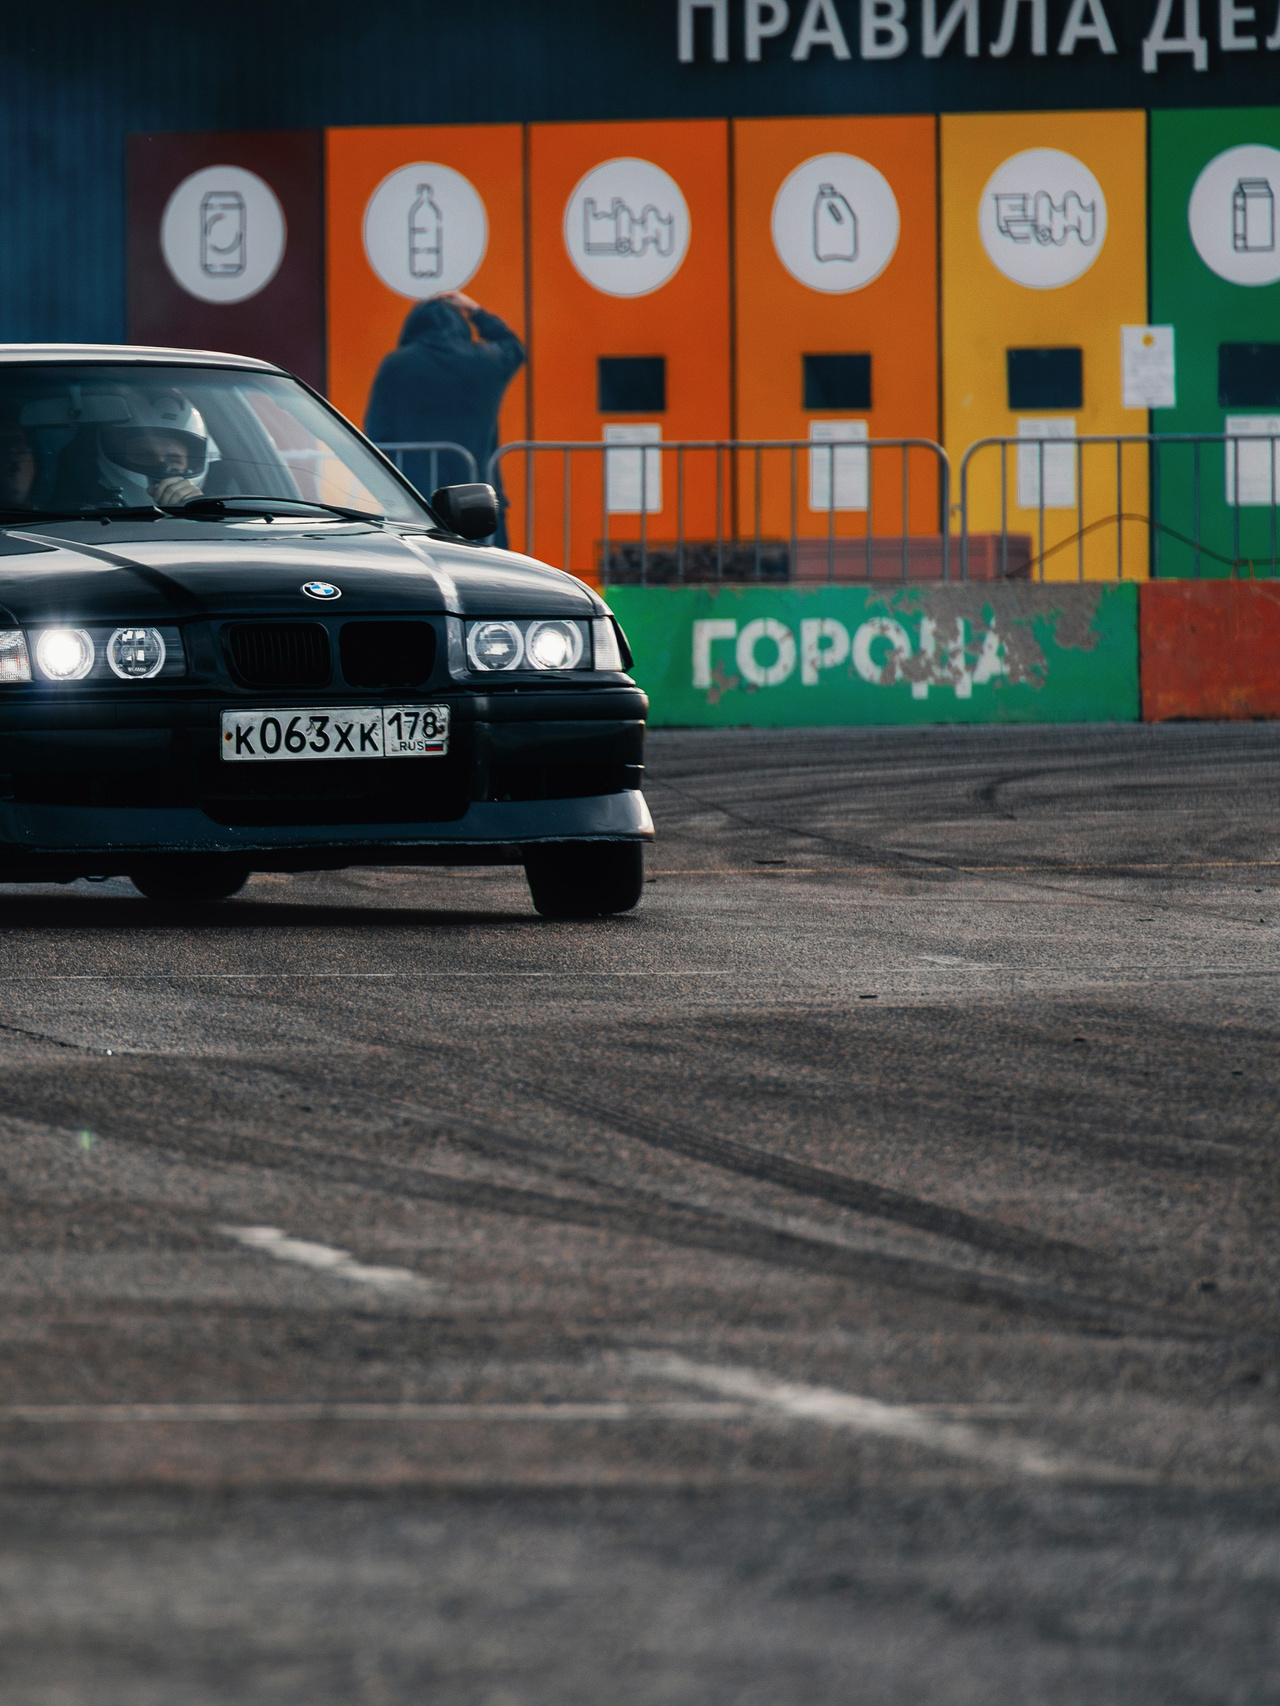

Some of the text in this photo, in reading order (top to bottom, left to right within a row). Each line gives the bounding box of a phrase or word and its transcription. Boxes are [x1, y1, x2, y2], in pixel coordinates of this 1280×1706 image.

[677, 0, 1280, 73] ПРАВИЛА ДЕ
[387, 711, 438, 741] 178
[399, 740, 425, 752] RUS
